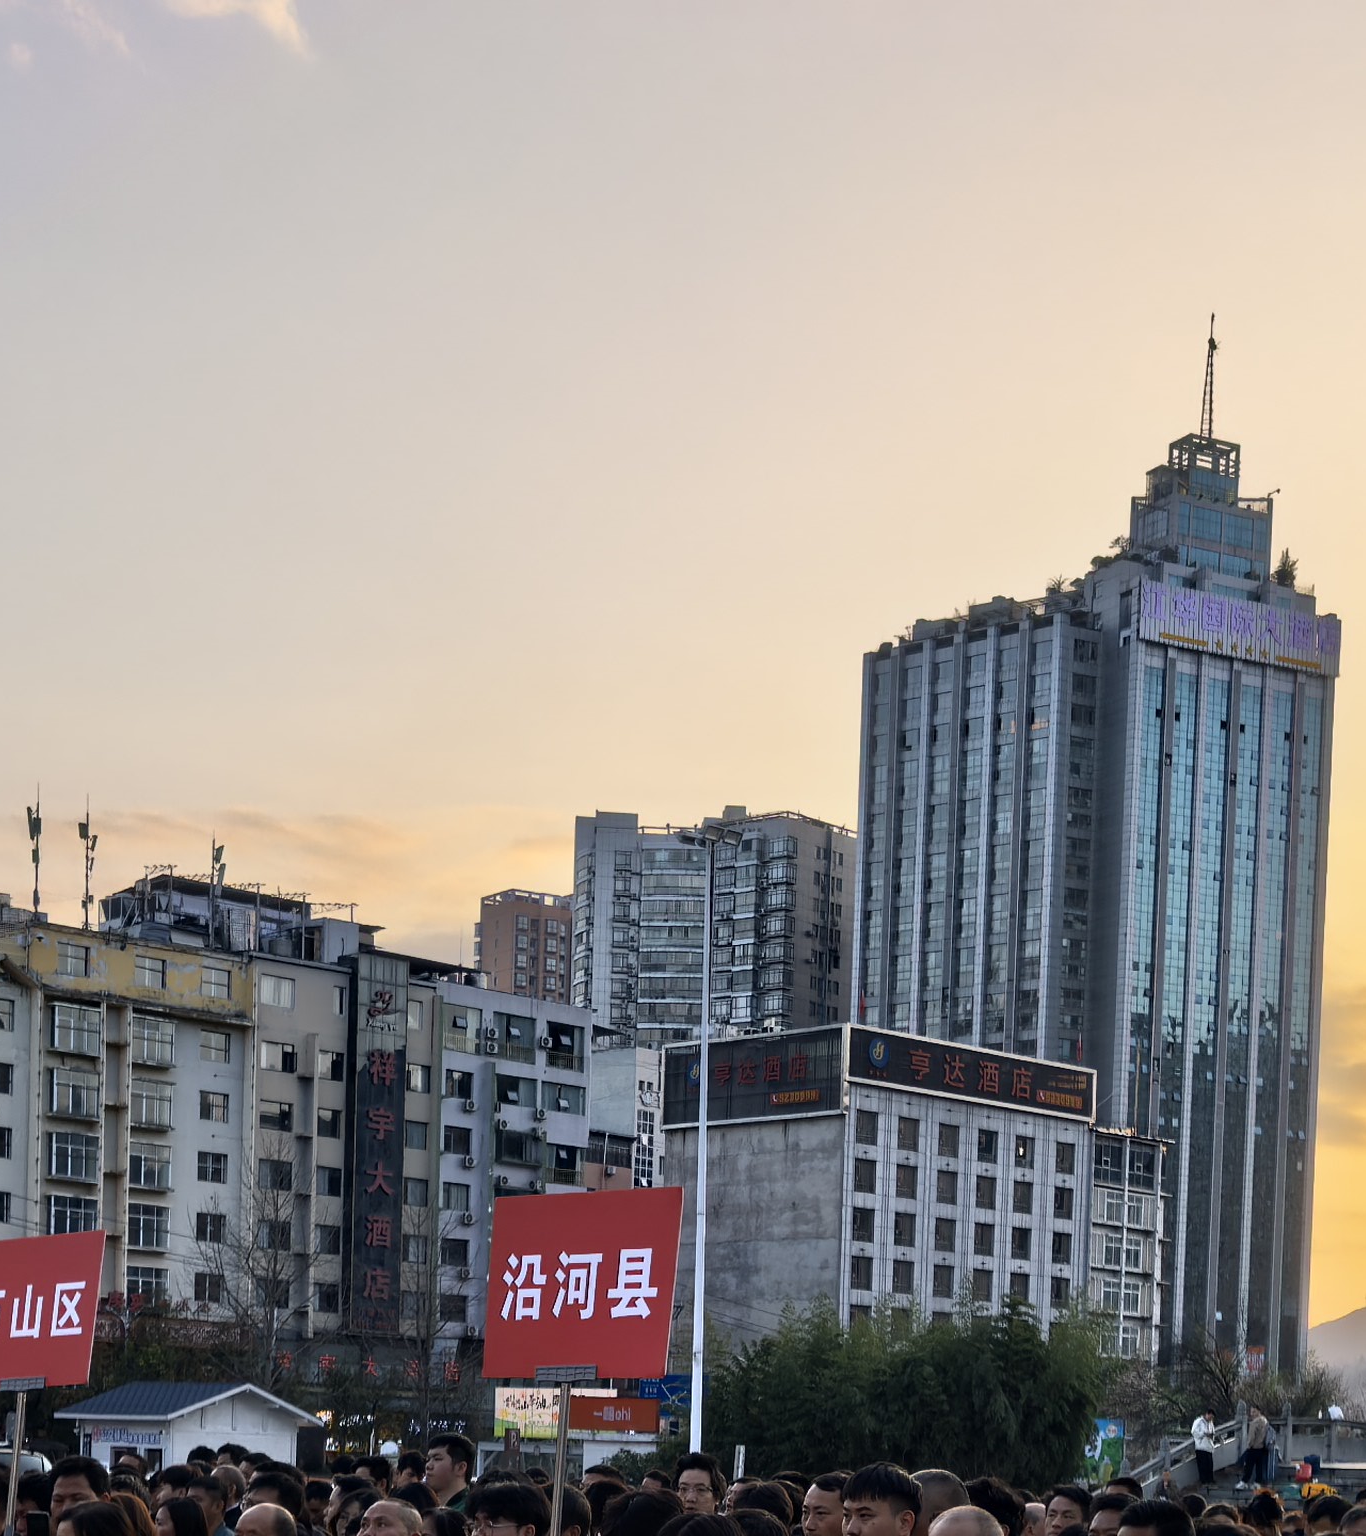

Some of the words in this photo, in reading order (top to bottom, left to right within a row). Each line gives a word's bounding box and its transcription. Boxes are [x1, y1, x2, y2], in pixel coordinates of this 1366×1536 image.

[714, 1054, 809, 1087] 亨达酒店
[908, 1049, 1033, 1100] 亨达酒店
[499, 1248, 659, 1322] 沿河县
